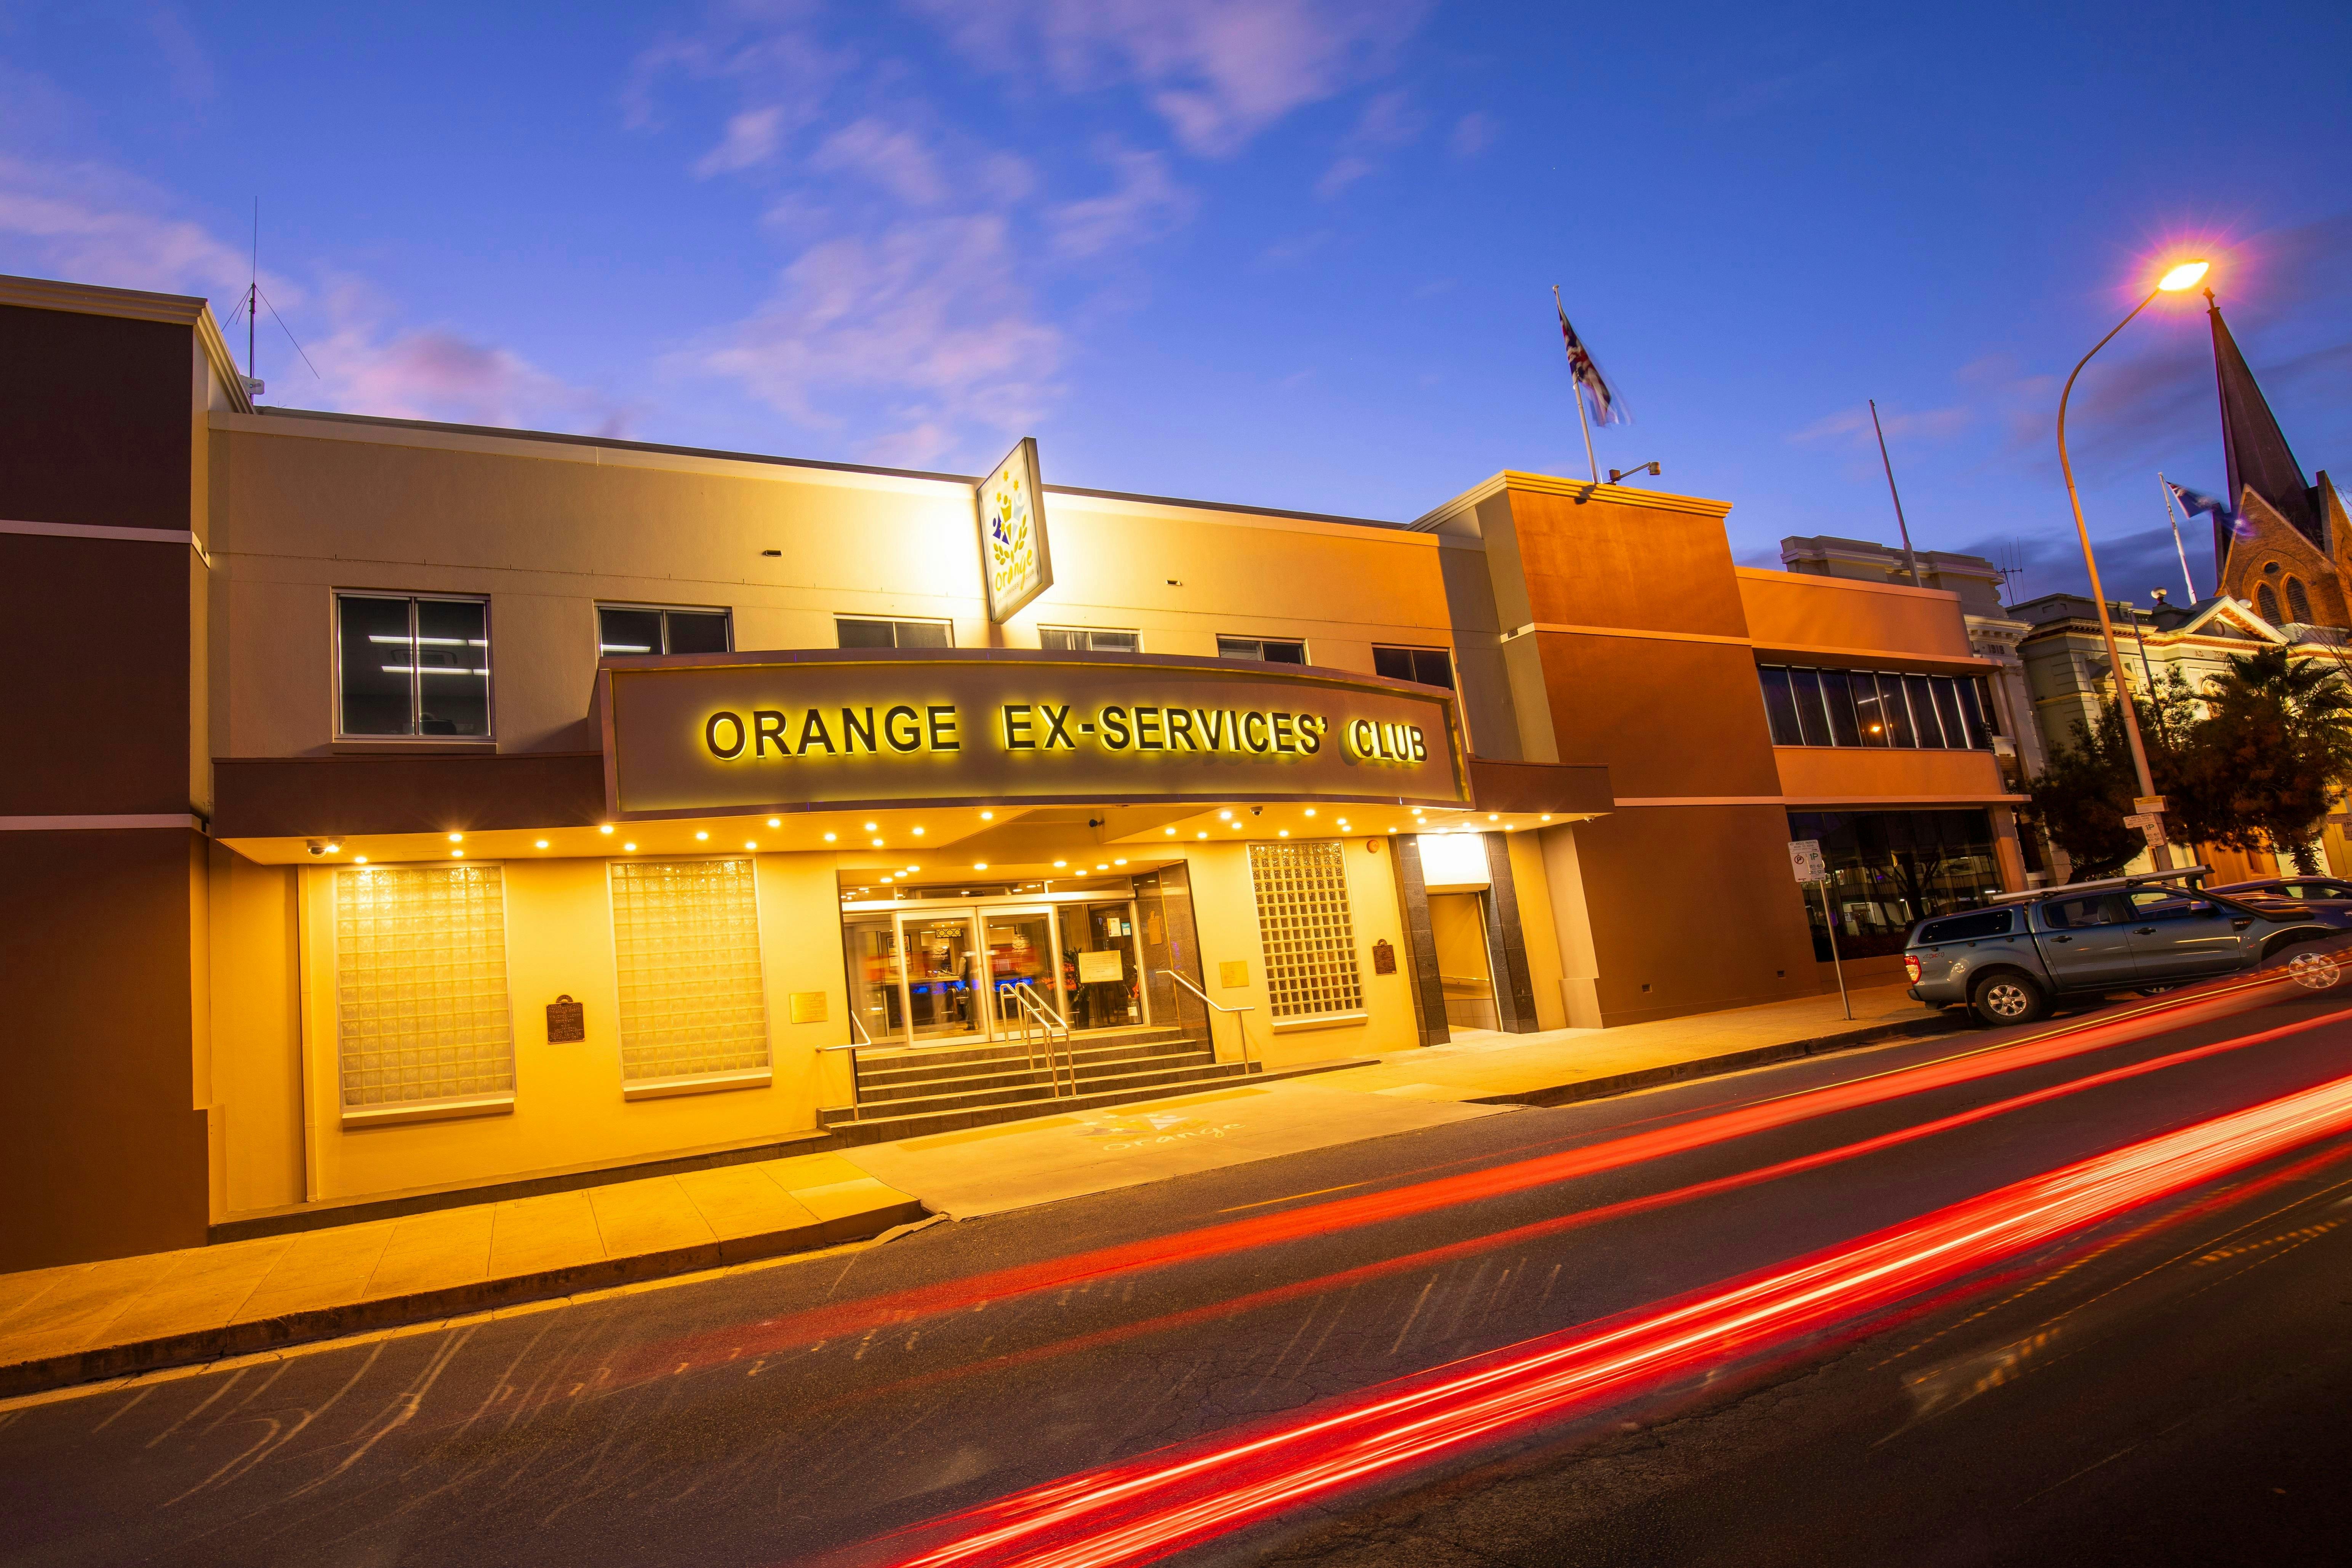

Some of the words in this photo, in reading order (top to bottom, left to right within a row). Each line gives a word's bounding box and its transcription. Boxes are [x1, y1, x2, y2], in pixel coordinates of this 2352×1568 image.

[996, 549, 1032, 591] orange
[1026, 569, 1034, 579] CLUB
[706, 705, 960, 760] ORANGE
[1001, 705, 1327, 755] EX-SERVICES'
[1349, 719, 1427, 763] CLUB
[1103, 1123, 1246, 1151] orange
